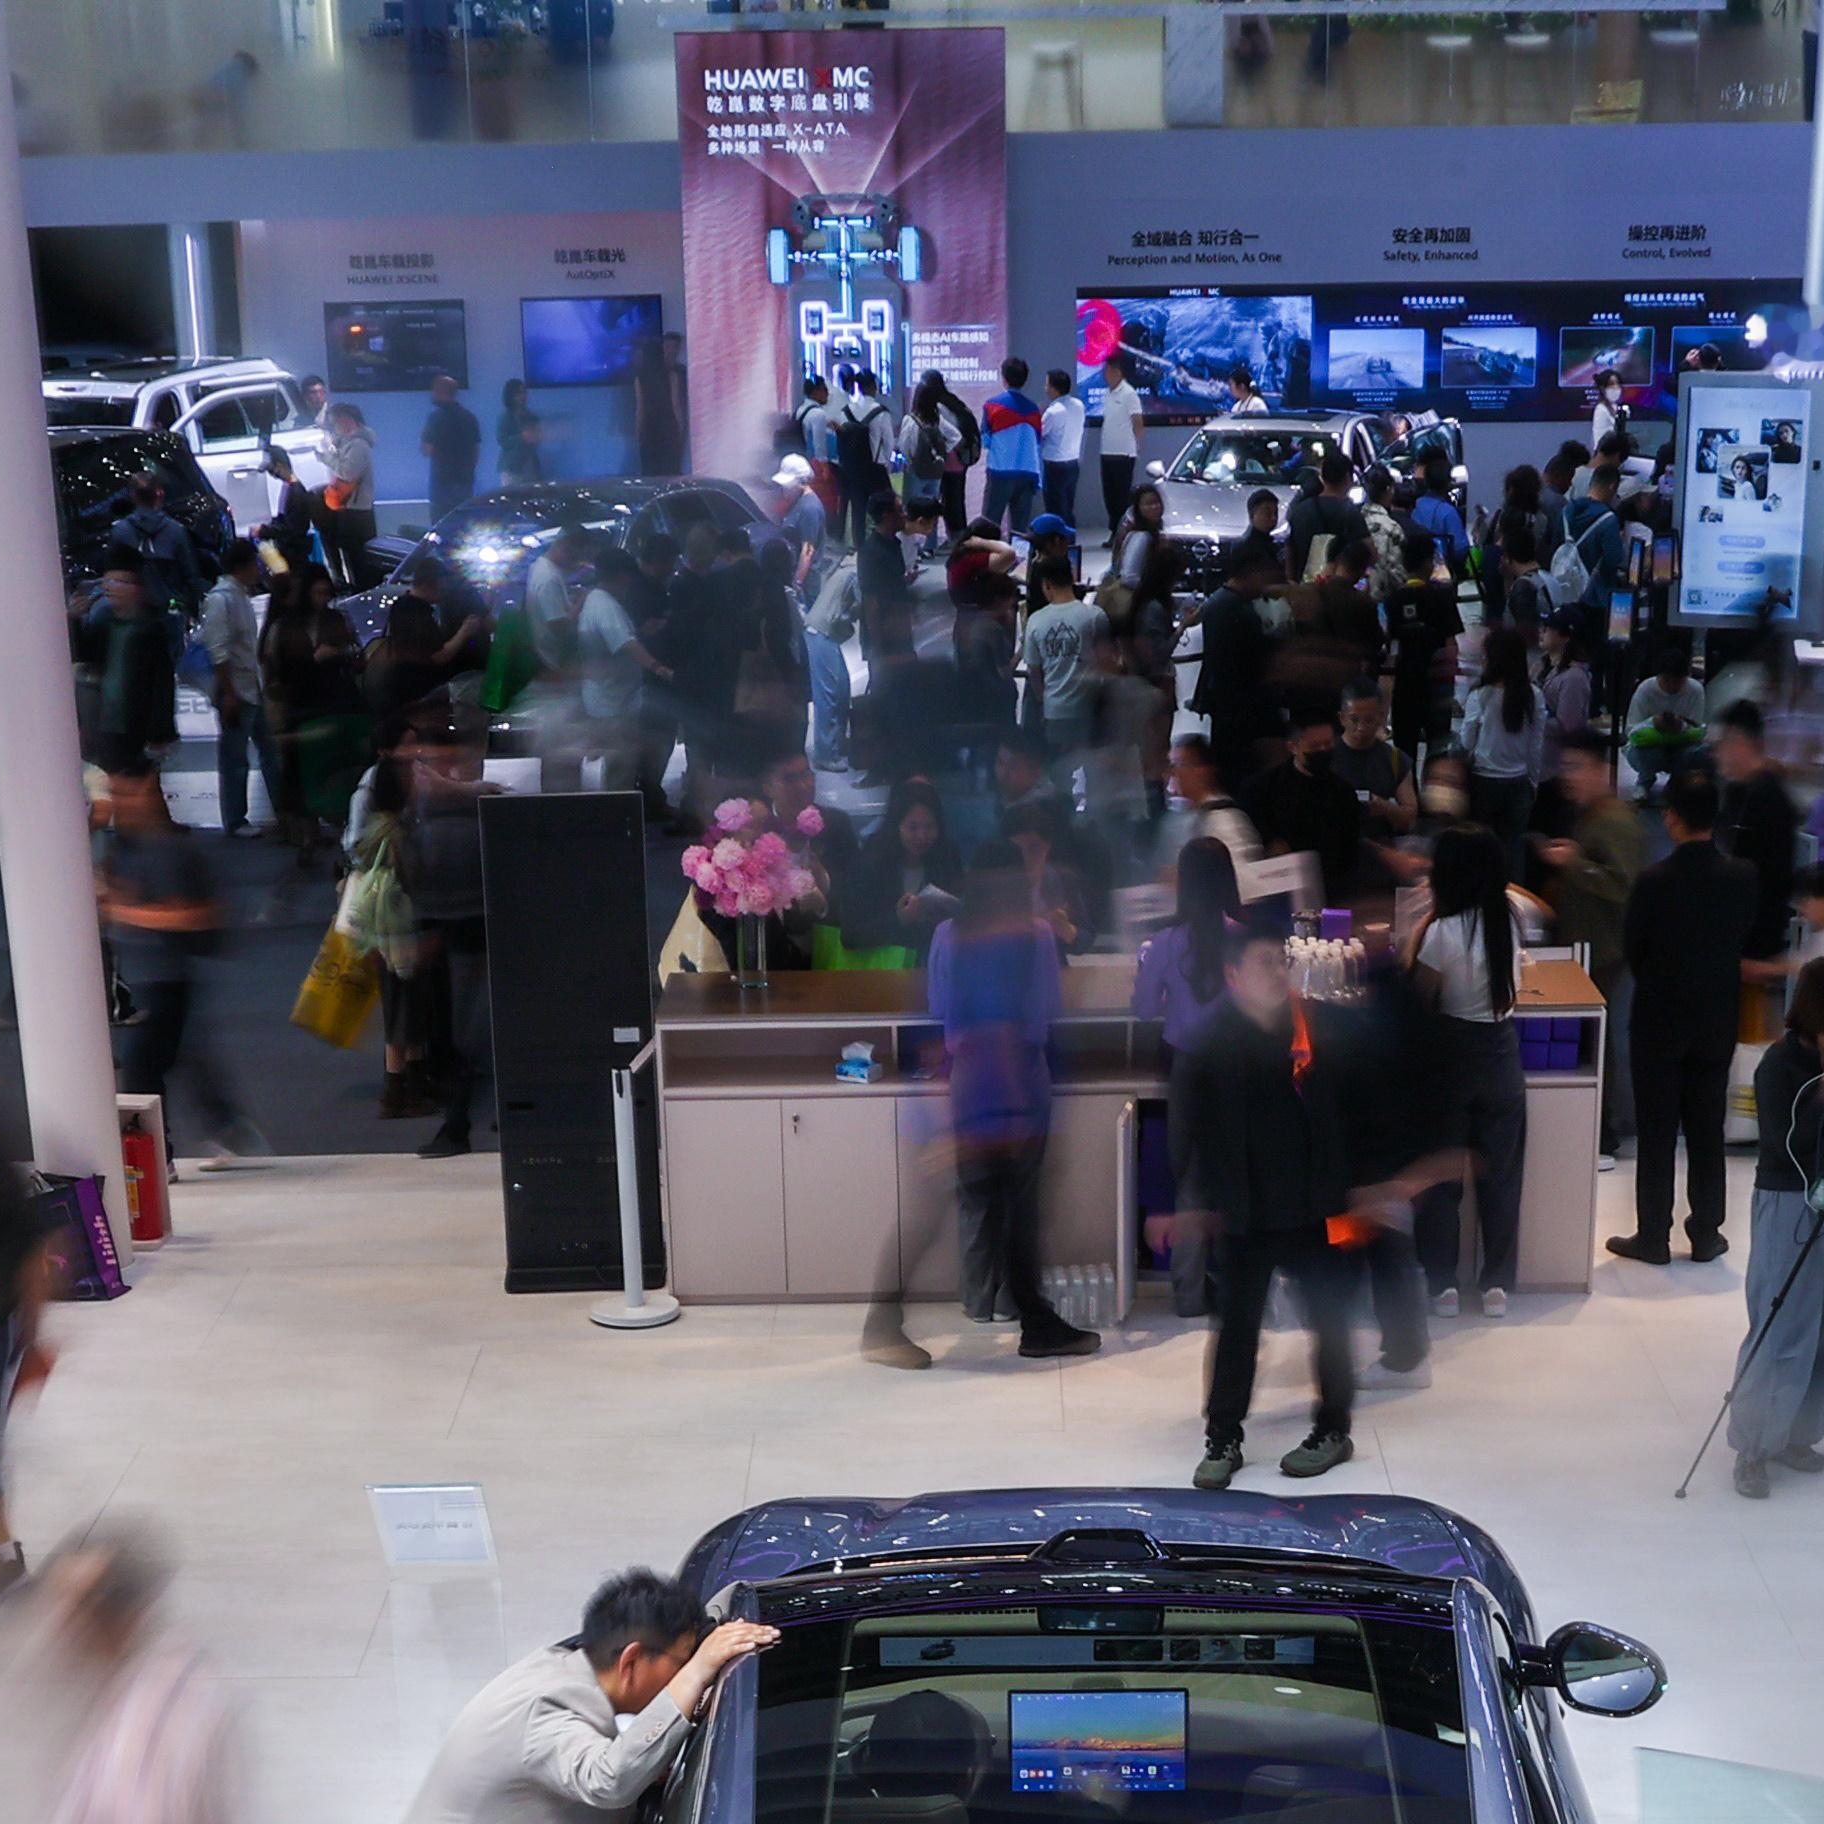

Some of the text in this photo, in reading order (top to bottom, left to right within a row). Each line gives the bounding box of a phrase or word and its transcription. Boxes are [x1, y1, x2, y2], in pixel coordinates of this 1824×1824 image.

[704, 68, 804, 90] HUAWEI
[706, 92, 871, 113] 乾崑数字底盘引擎
[793, 122, 846, 136] X-ATA
[1198, 229, 1259, 246] 知行合一
[1392, 227, 1471, 243] 安全再加固
[1628, 224, 1707, 241] 操控再进阶
[1107, 250, 1282, 267] Perception and Motion, As One
[1384, 249, 1478, 262] Safety, Enhanced
[1622, 247, 1712, 259] Control, Evolved
